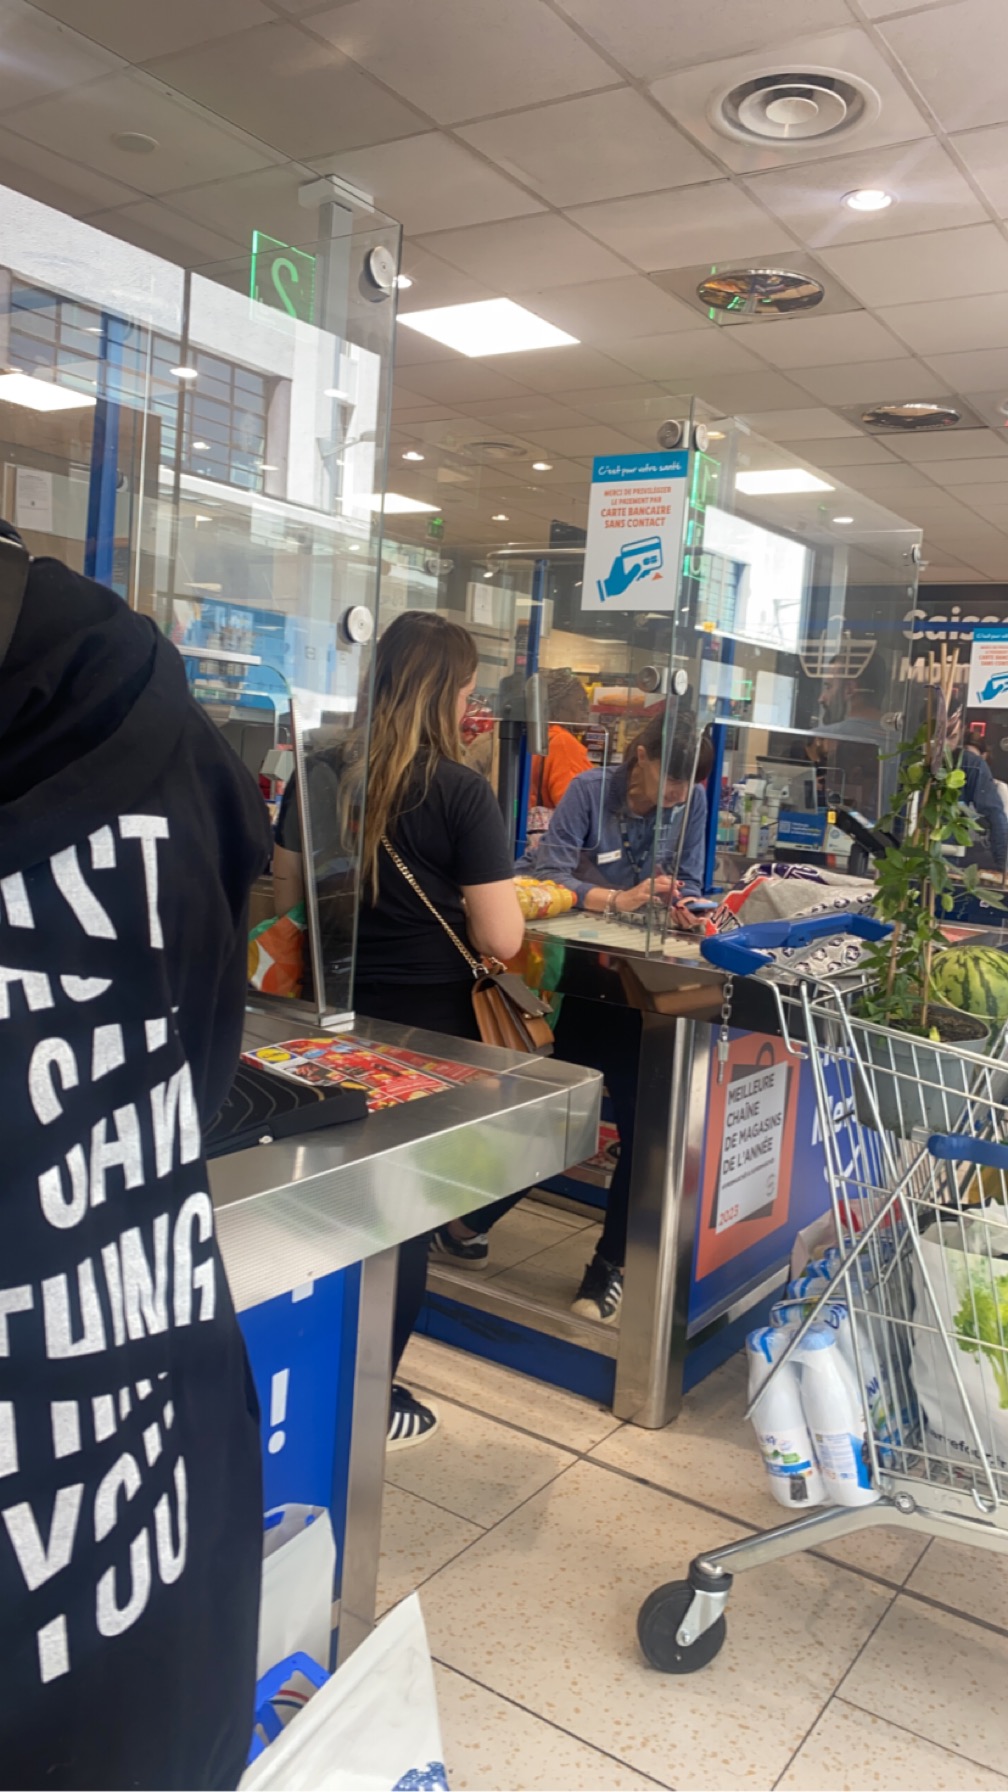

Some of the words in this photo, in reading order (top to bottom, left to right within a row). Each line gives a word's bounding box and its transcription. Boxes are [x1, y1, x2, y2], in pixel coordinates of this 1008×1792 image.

[604, 489, 623, 497] MERCI
[601, 508, 627, 517] CARTE
[628, 505, 672, 516] BANCAIRE
[605, 519, 625, 528] SANS
[627, 517, 666, 528] CONTACT
[728, 1073, 776, 1105] MEILLEURE
[727, 1101, 760, 1127] CHAÎNE
[725, 1132, 737, 1151] DE
[739, 1112, 783, 1144] MAGASINS
[722, 1158, 735, 1175] DE
[737, 1136, 774, 1169] L'ANNÉE
